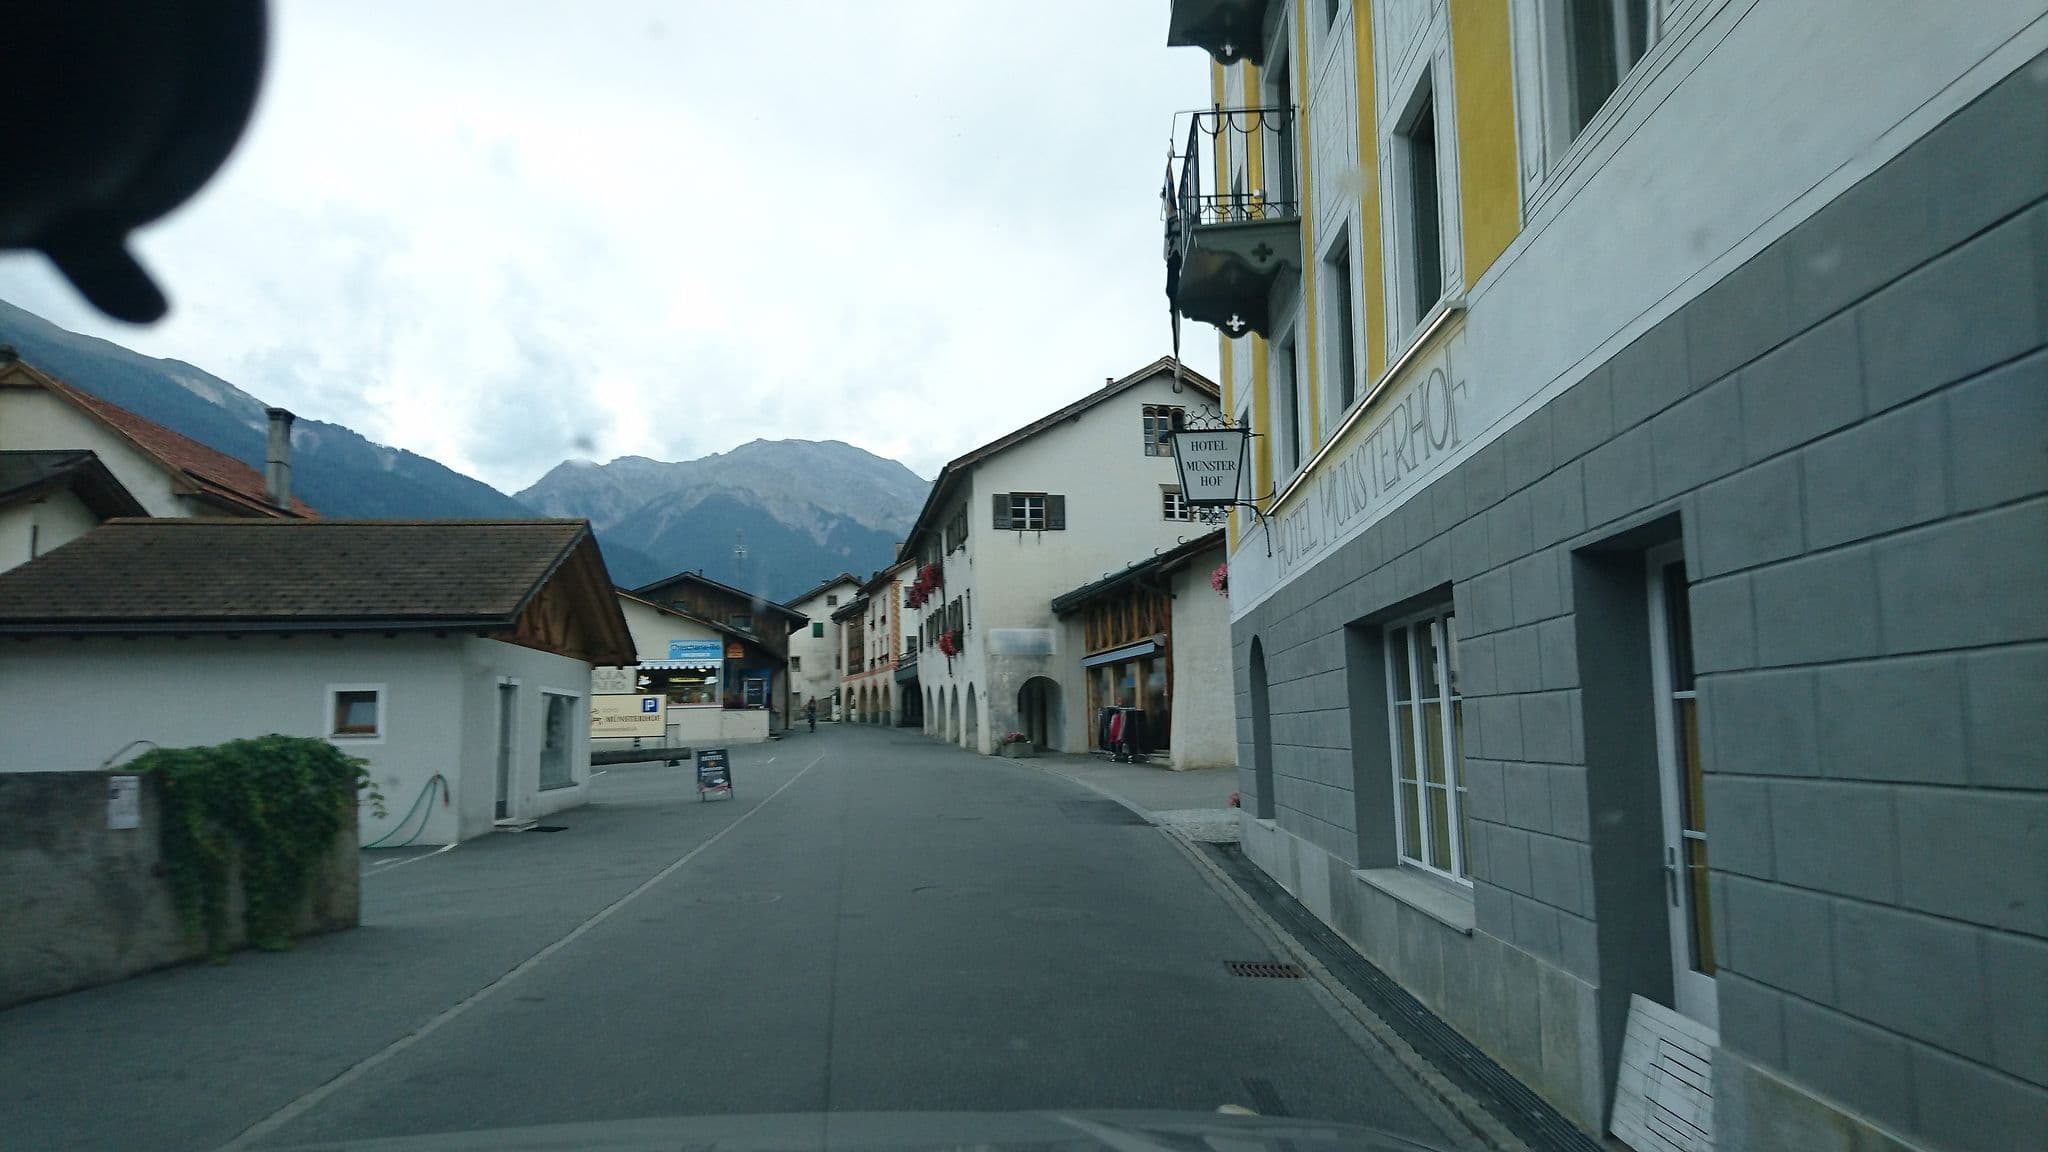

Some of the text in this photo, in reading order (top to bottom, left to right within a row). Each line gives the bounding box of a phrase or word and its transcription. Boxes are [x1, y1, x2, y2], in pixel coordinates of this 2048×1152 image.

[1191, 440, 1227, 451] HOTEL
[1200, 476, 1223, 486] HOF
[1274, 498, 1317, 578] HOTEL
[644, 700, 656, 711] P
